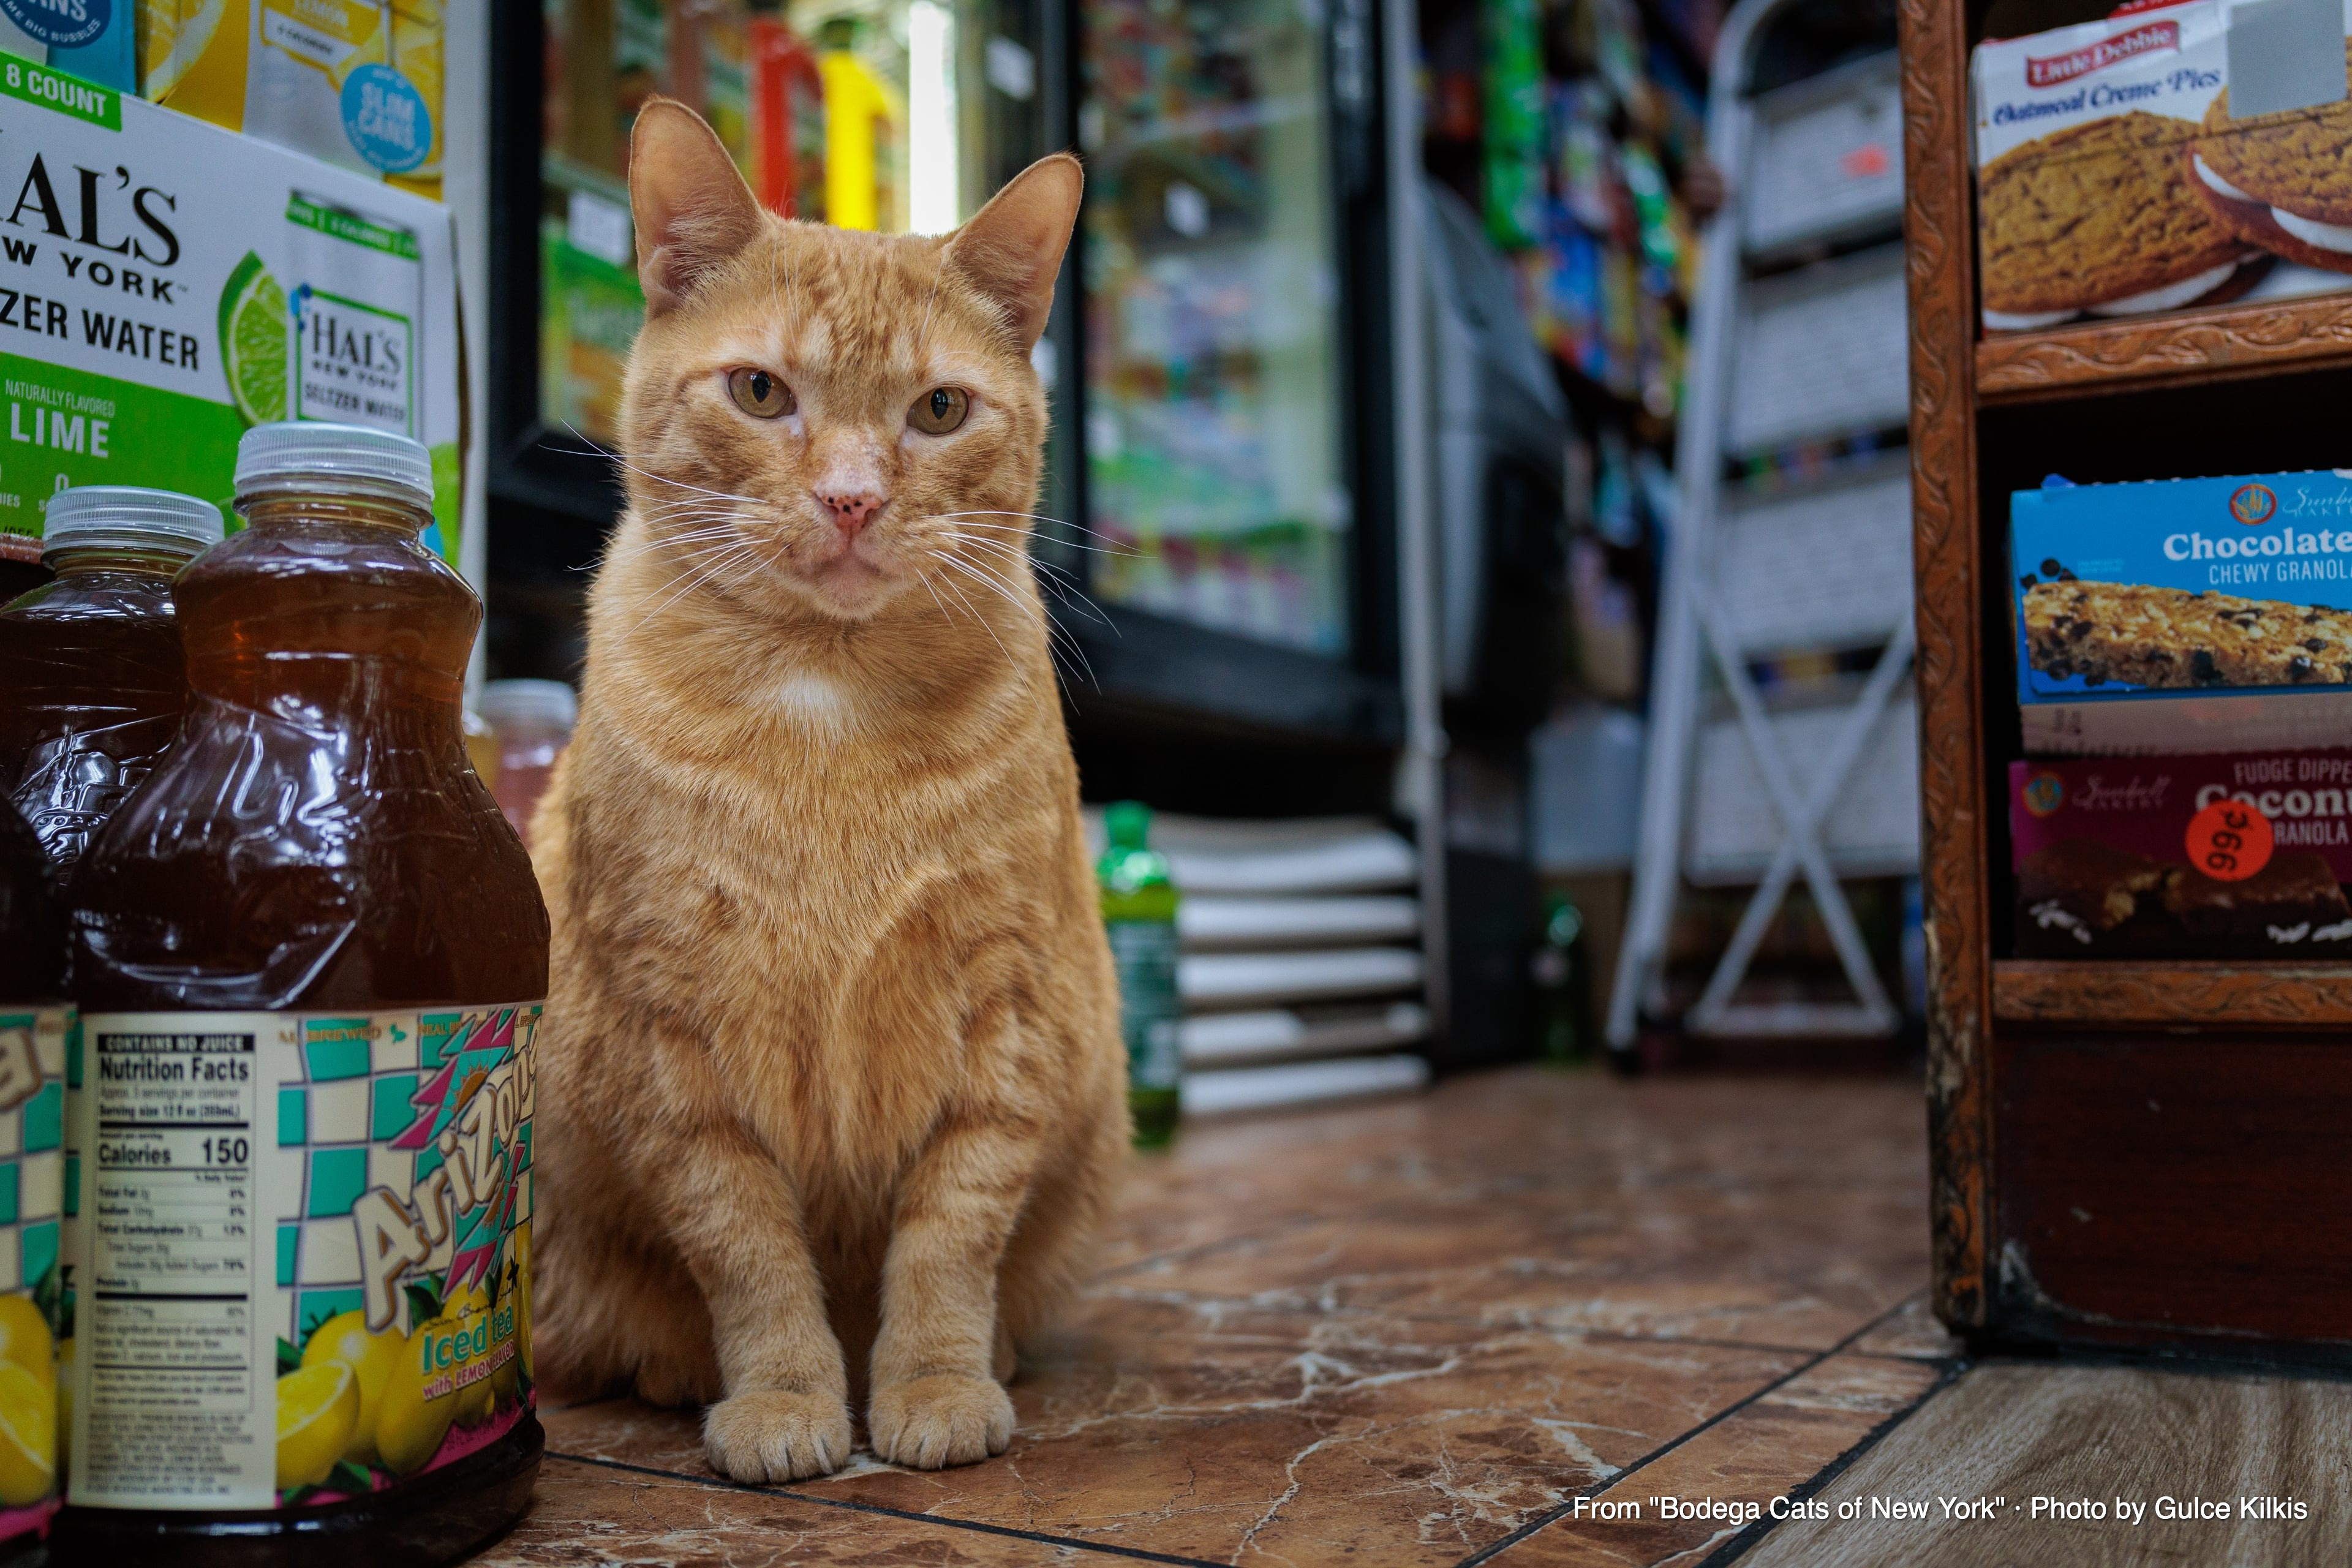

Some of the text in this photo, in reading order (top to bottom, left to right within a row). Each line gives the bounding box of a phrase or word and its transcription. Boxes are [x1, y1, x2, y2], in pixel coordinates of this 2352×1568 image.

[2, 0, 101, 43] ME BIG BUBBLES
[28, 0, 88, 22] NS
[2031, 27, 2171, 85] Little Debbie
[6, 63, 107, 117] 8 COUNT
[1994, 69, 2221, 126] Oatmeal Creme Pies
[0, 151, 179, 268] AL'S
[81, 308, 198, 371] WATER
[313, 312, 401, 375] HAL'S
[6, 379, 116, 418] NATURALLY FLAVORED
[306, 383, 360, 413] SELTZER
[11, 402, 109, 458] LIME
[2283, 486, 2352, 514] Sunb
[2163, 527, 2352, 560] Chocolate
[2209, 559, 2352, 585] CHEWY GRANOL
[2234, 758, 2293, 785] FUDGE
[2274, 820, 2350, 846] RANOLA
[100, 1057, 249, 1082] Nutrition Facts
[99, 1137, 249, 1164] Calories 150
[423, 1304, 513, 1374] Iced tea
[423, 1339, 514, 1401] with LEMON FLAVOR
